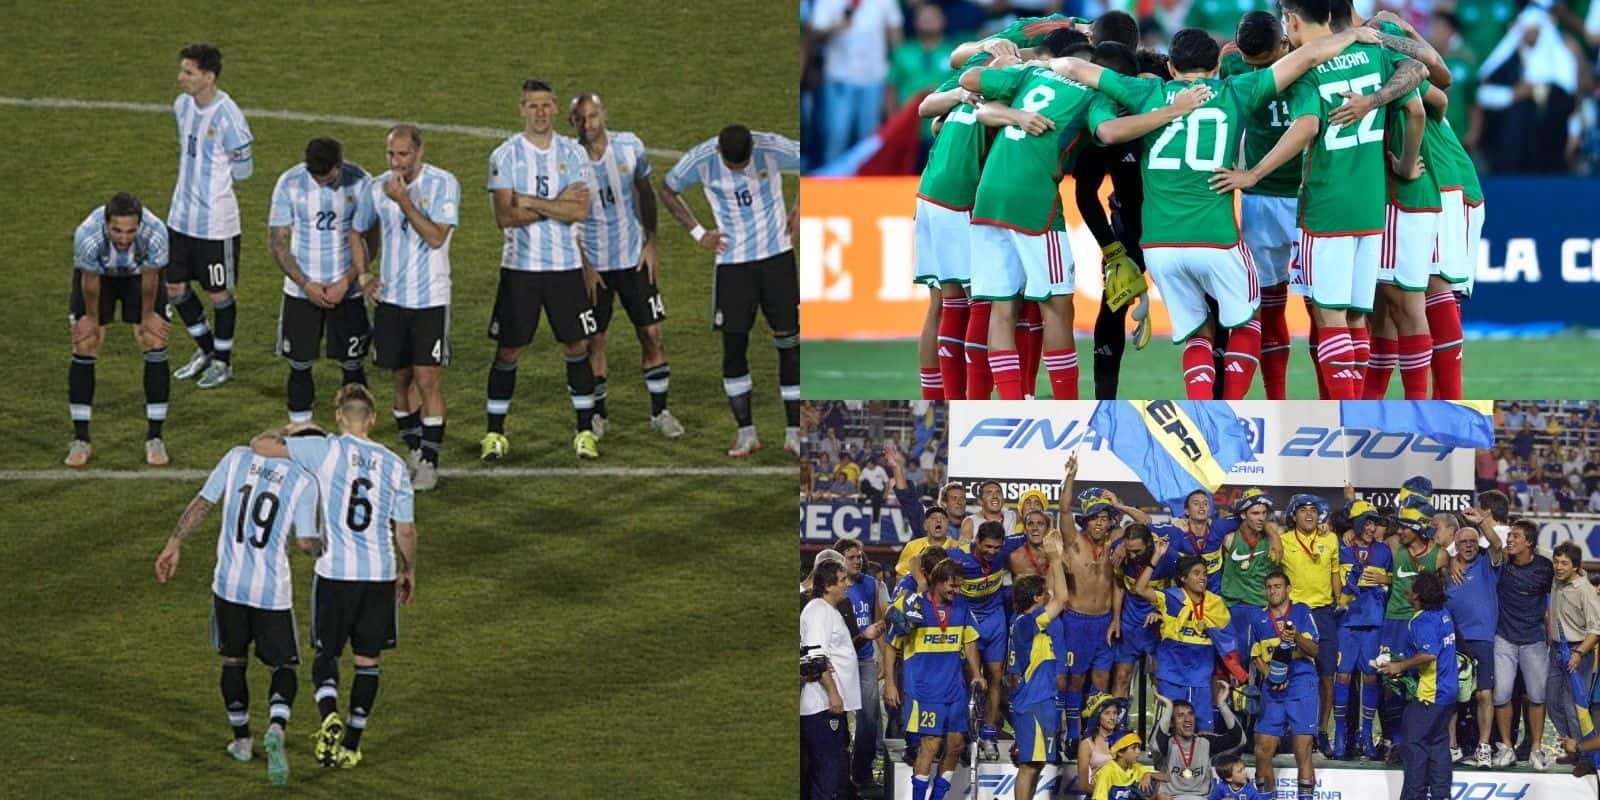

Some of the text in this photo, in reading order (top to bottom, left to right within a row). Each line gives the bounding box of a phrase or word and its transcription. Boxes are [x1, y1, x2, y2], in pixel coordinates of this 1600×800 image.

[1328, 51, 1370, 71] LOZANO
[1318, 72, 1384, 151] 22
[1147, 107, 1227, 171] 20
[535, 175, 549, 198] 15
[599, 189, 615, 209] 14
[734, 190, 753, 208] 16
[315, 210, 337, 231] 22
[1476, 238, 1542, 282] LA
[207, 263, 225, 287] 10
[648, 294, 666, 320] 14
[579, 309, 598, 335] 15
[431, 340, 442, 363] 4
[1146, 400, 1202, 463] EPSI
[1278, 426, 1457, 461] 2004
[236, 483, 280, 549] 19
[346, 477, 373, 532] 6
[920, 711, 937, 728] 23
